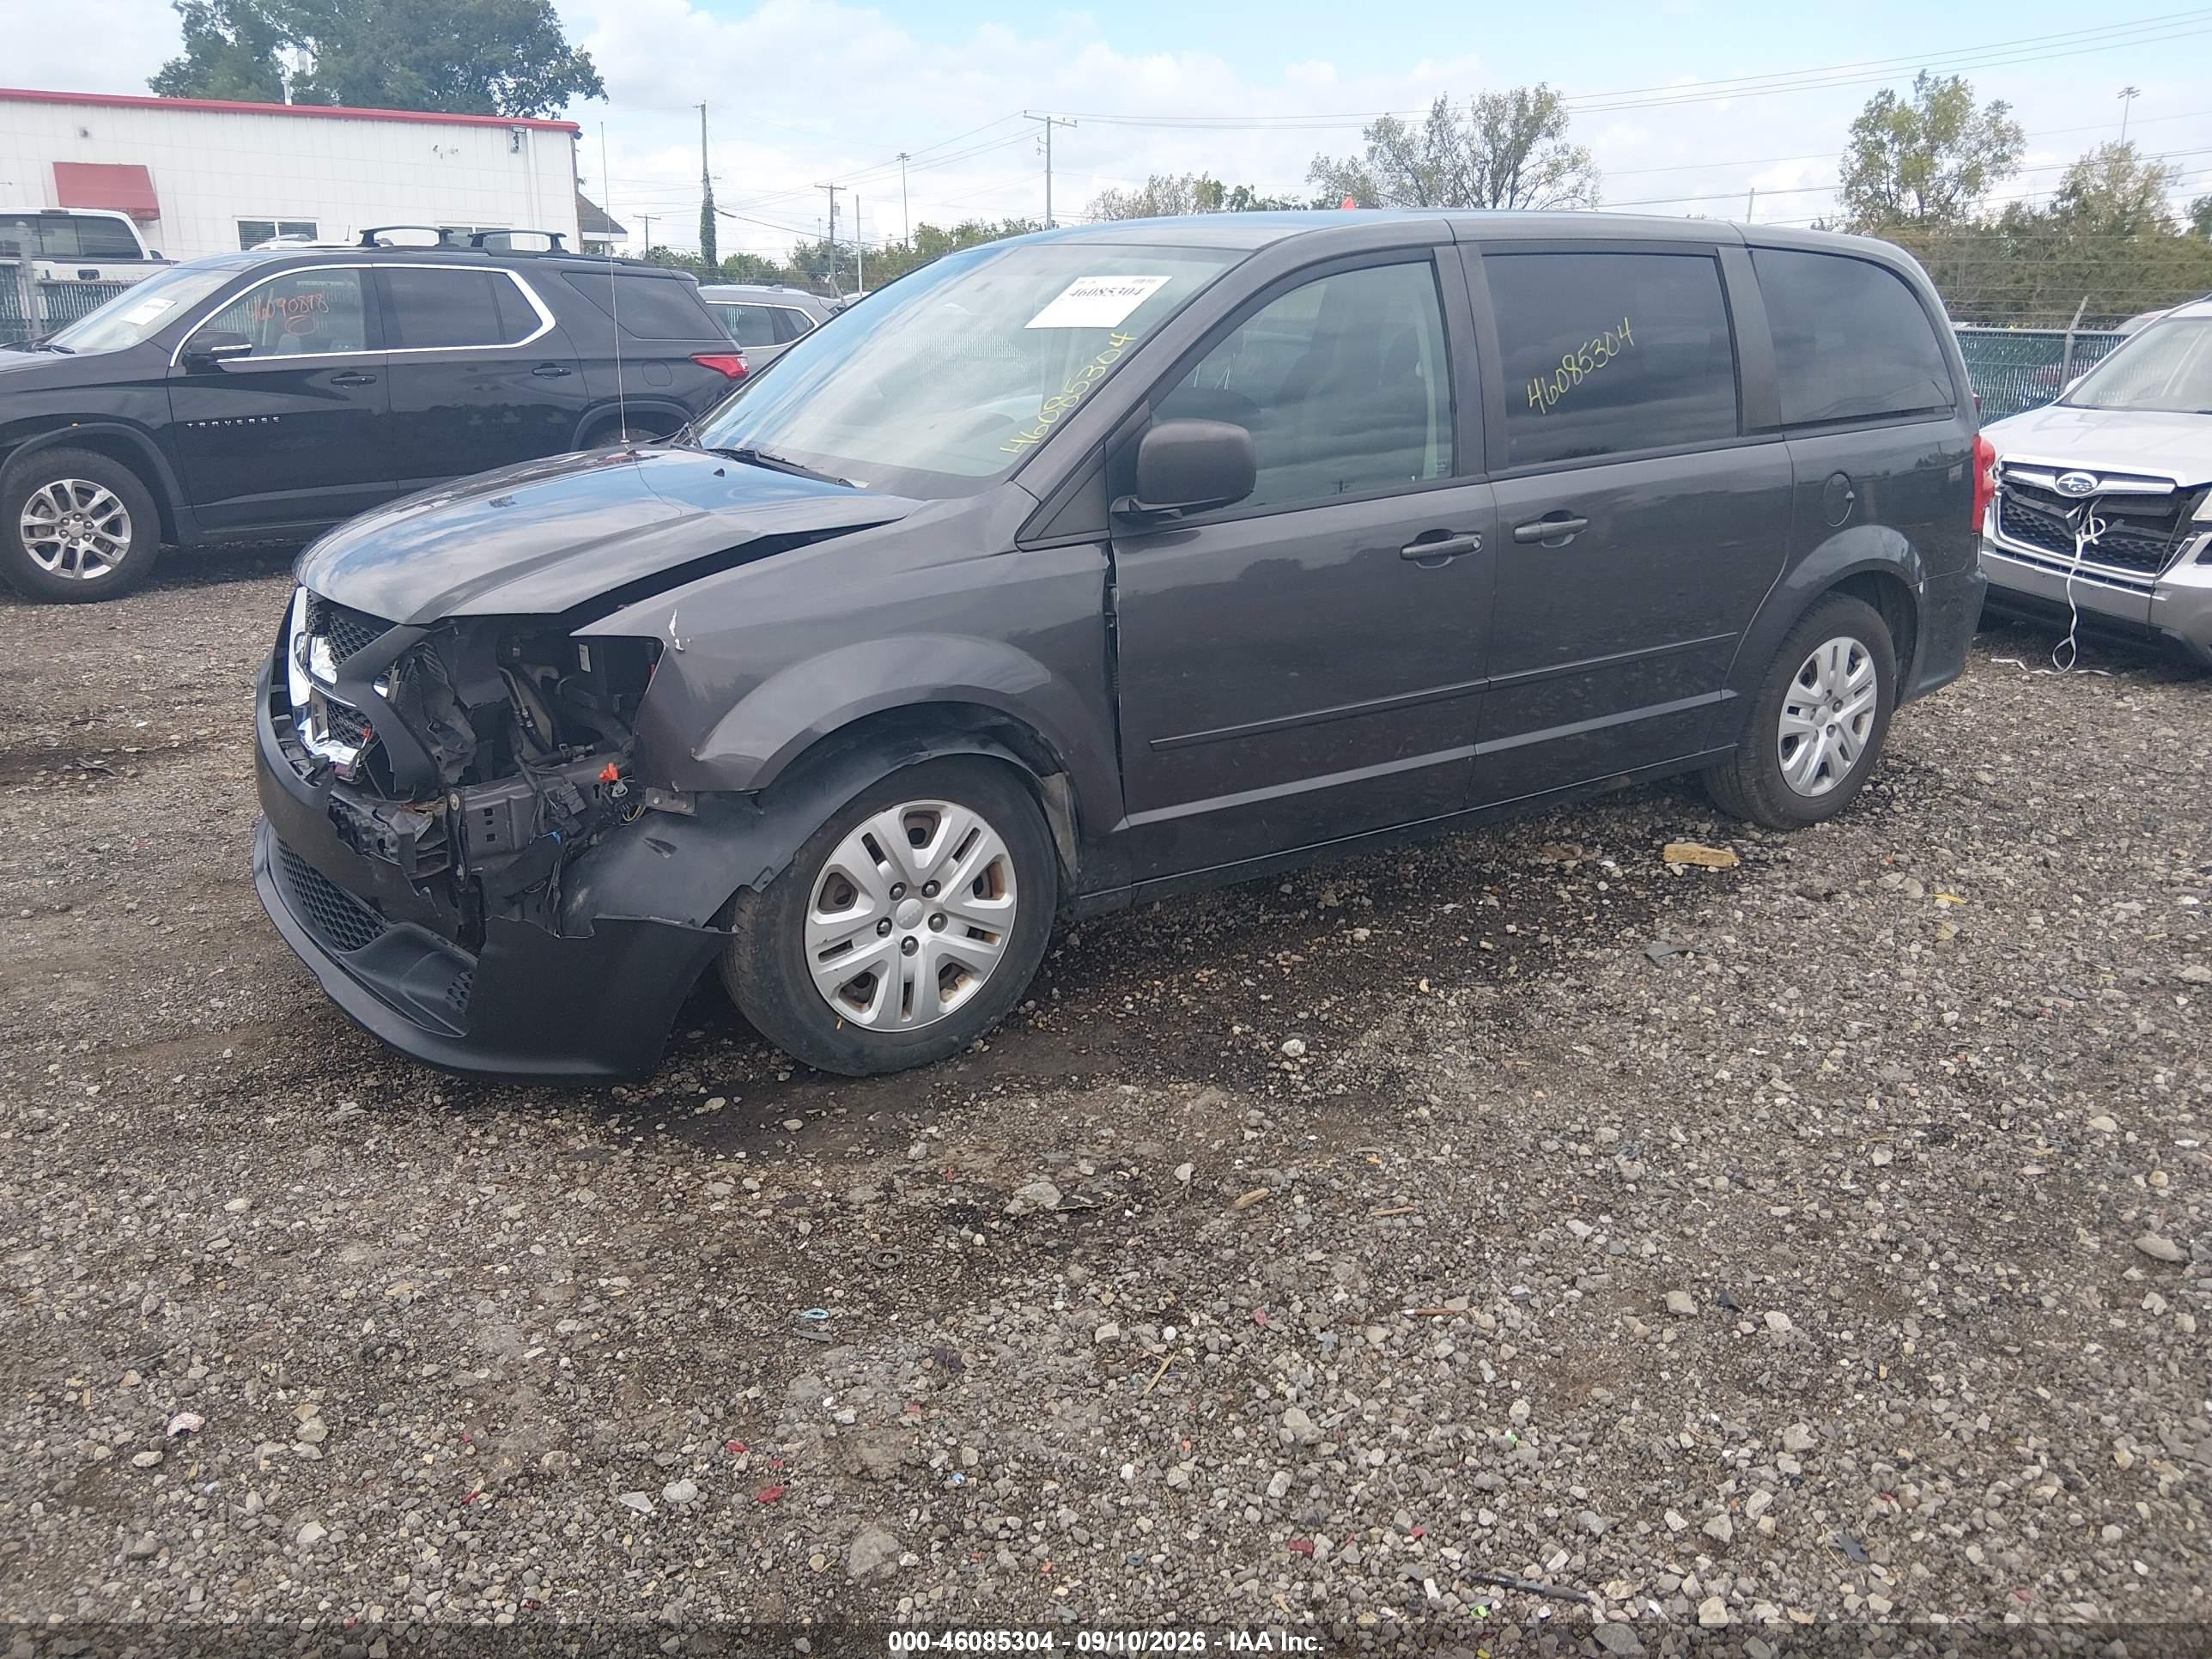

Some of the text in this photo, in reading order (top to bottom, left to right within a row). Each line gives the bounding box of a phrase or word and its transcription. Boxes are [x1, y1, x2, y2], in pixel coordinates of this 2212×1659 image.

[1068, 287, 1146, 297] 46085304
[999, 331, 1139, 453] 46085304
[1527, 316, 1635, 416] 46085304
[185, 416, 282, 430] TRAVERSE
